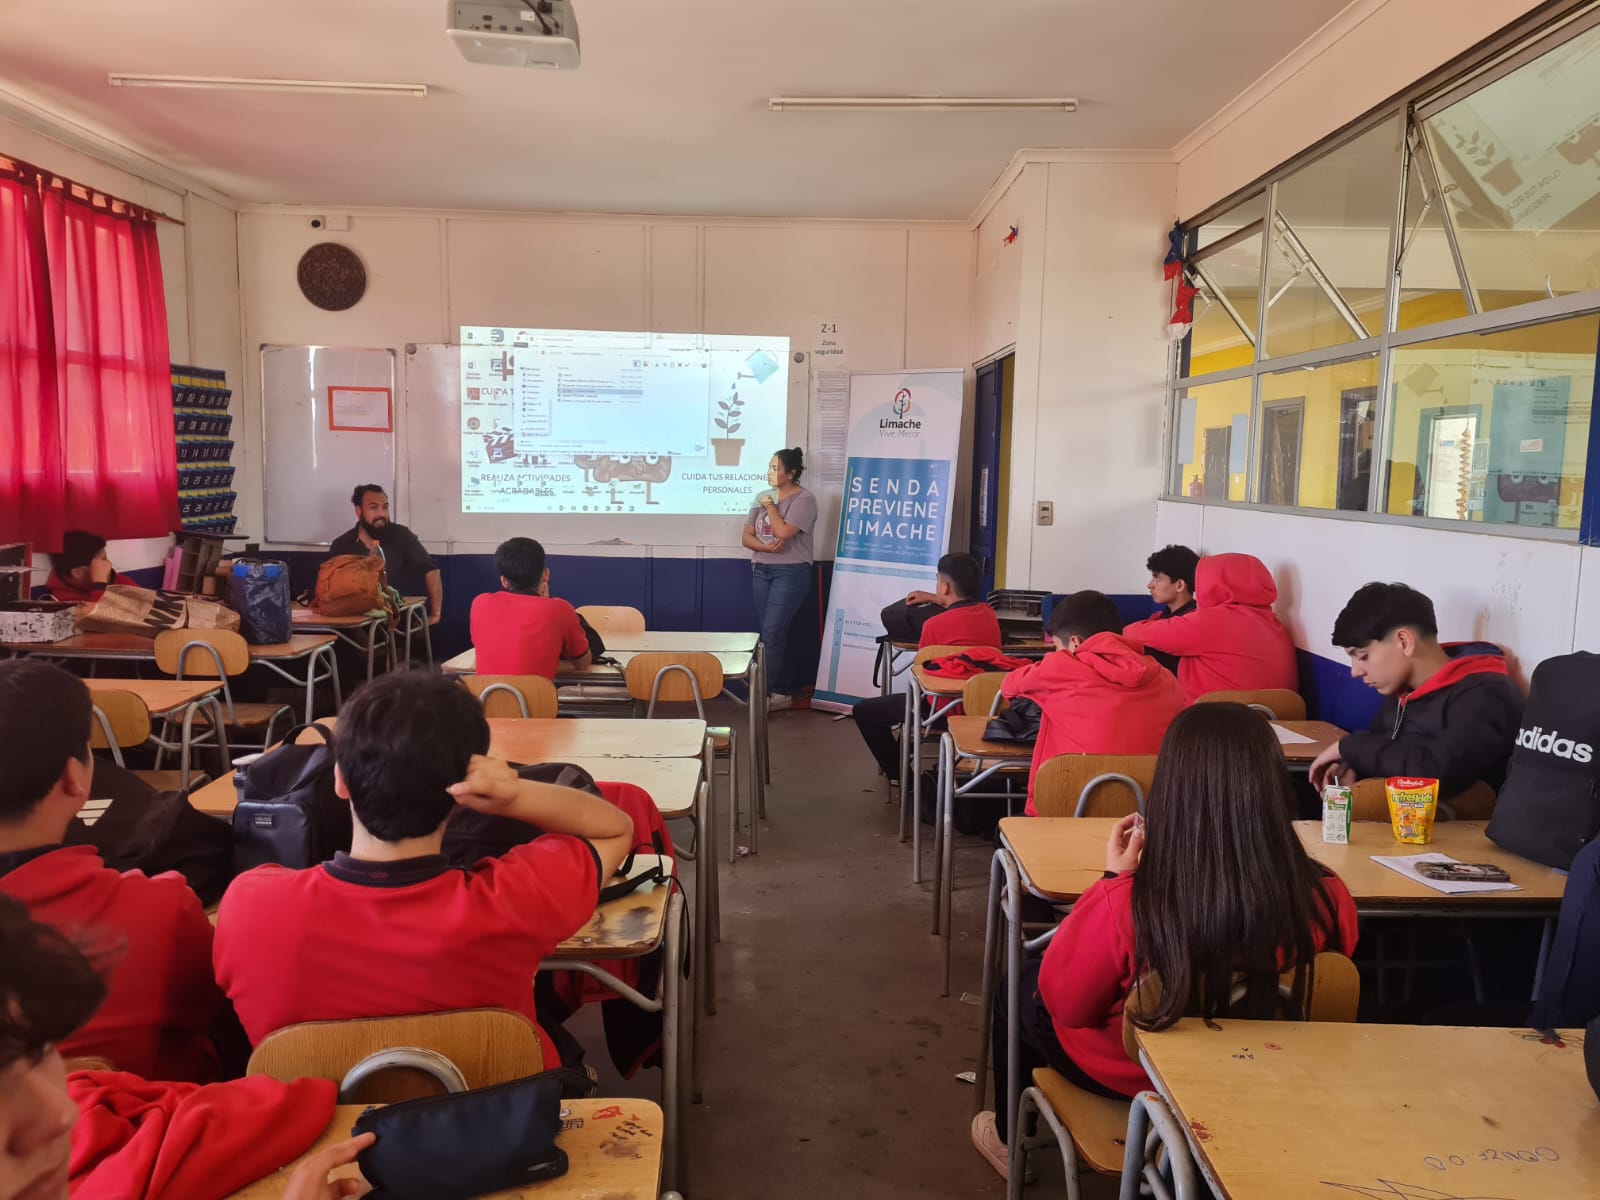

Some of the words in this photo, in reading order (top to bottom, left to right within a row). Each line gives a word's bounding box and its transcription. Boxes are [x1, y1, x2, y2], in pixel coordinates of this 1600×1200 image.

[821, 323, 836, 333] Z-1
[879, 418, 921, 429] Limache
[880, 429, 896, 438] Vive
[898, 429, 921, 439] Mejor
[681, 473, 707, 481] CUIDA
[708, 473, 724, 481] TUS
[724, 473, 769, 482] RELACIONE
[702, 486, 753, 494] PERSONALES
[851, 476, 940, 497] SENDA
[848, 497, 939, 519] PREVIENE
[845, 518, 937, 541] LIMACHE
